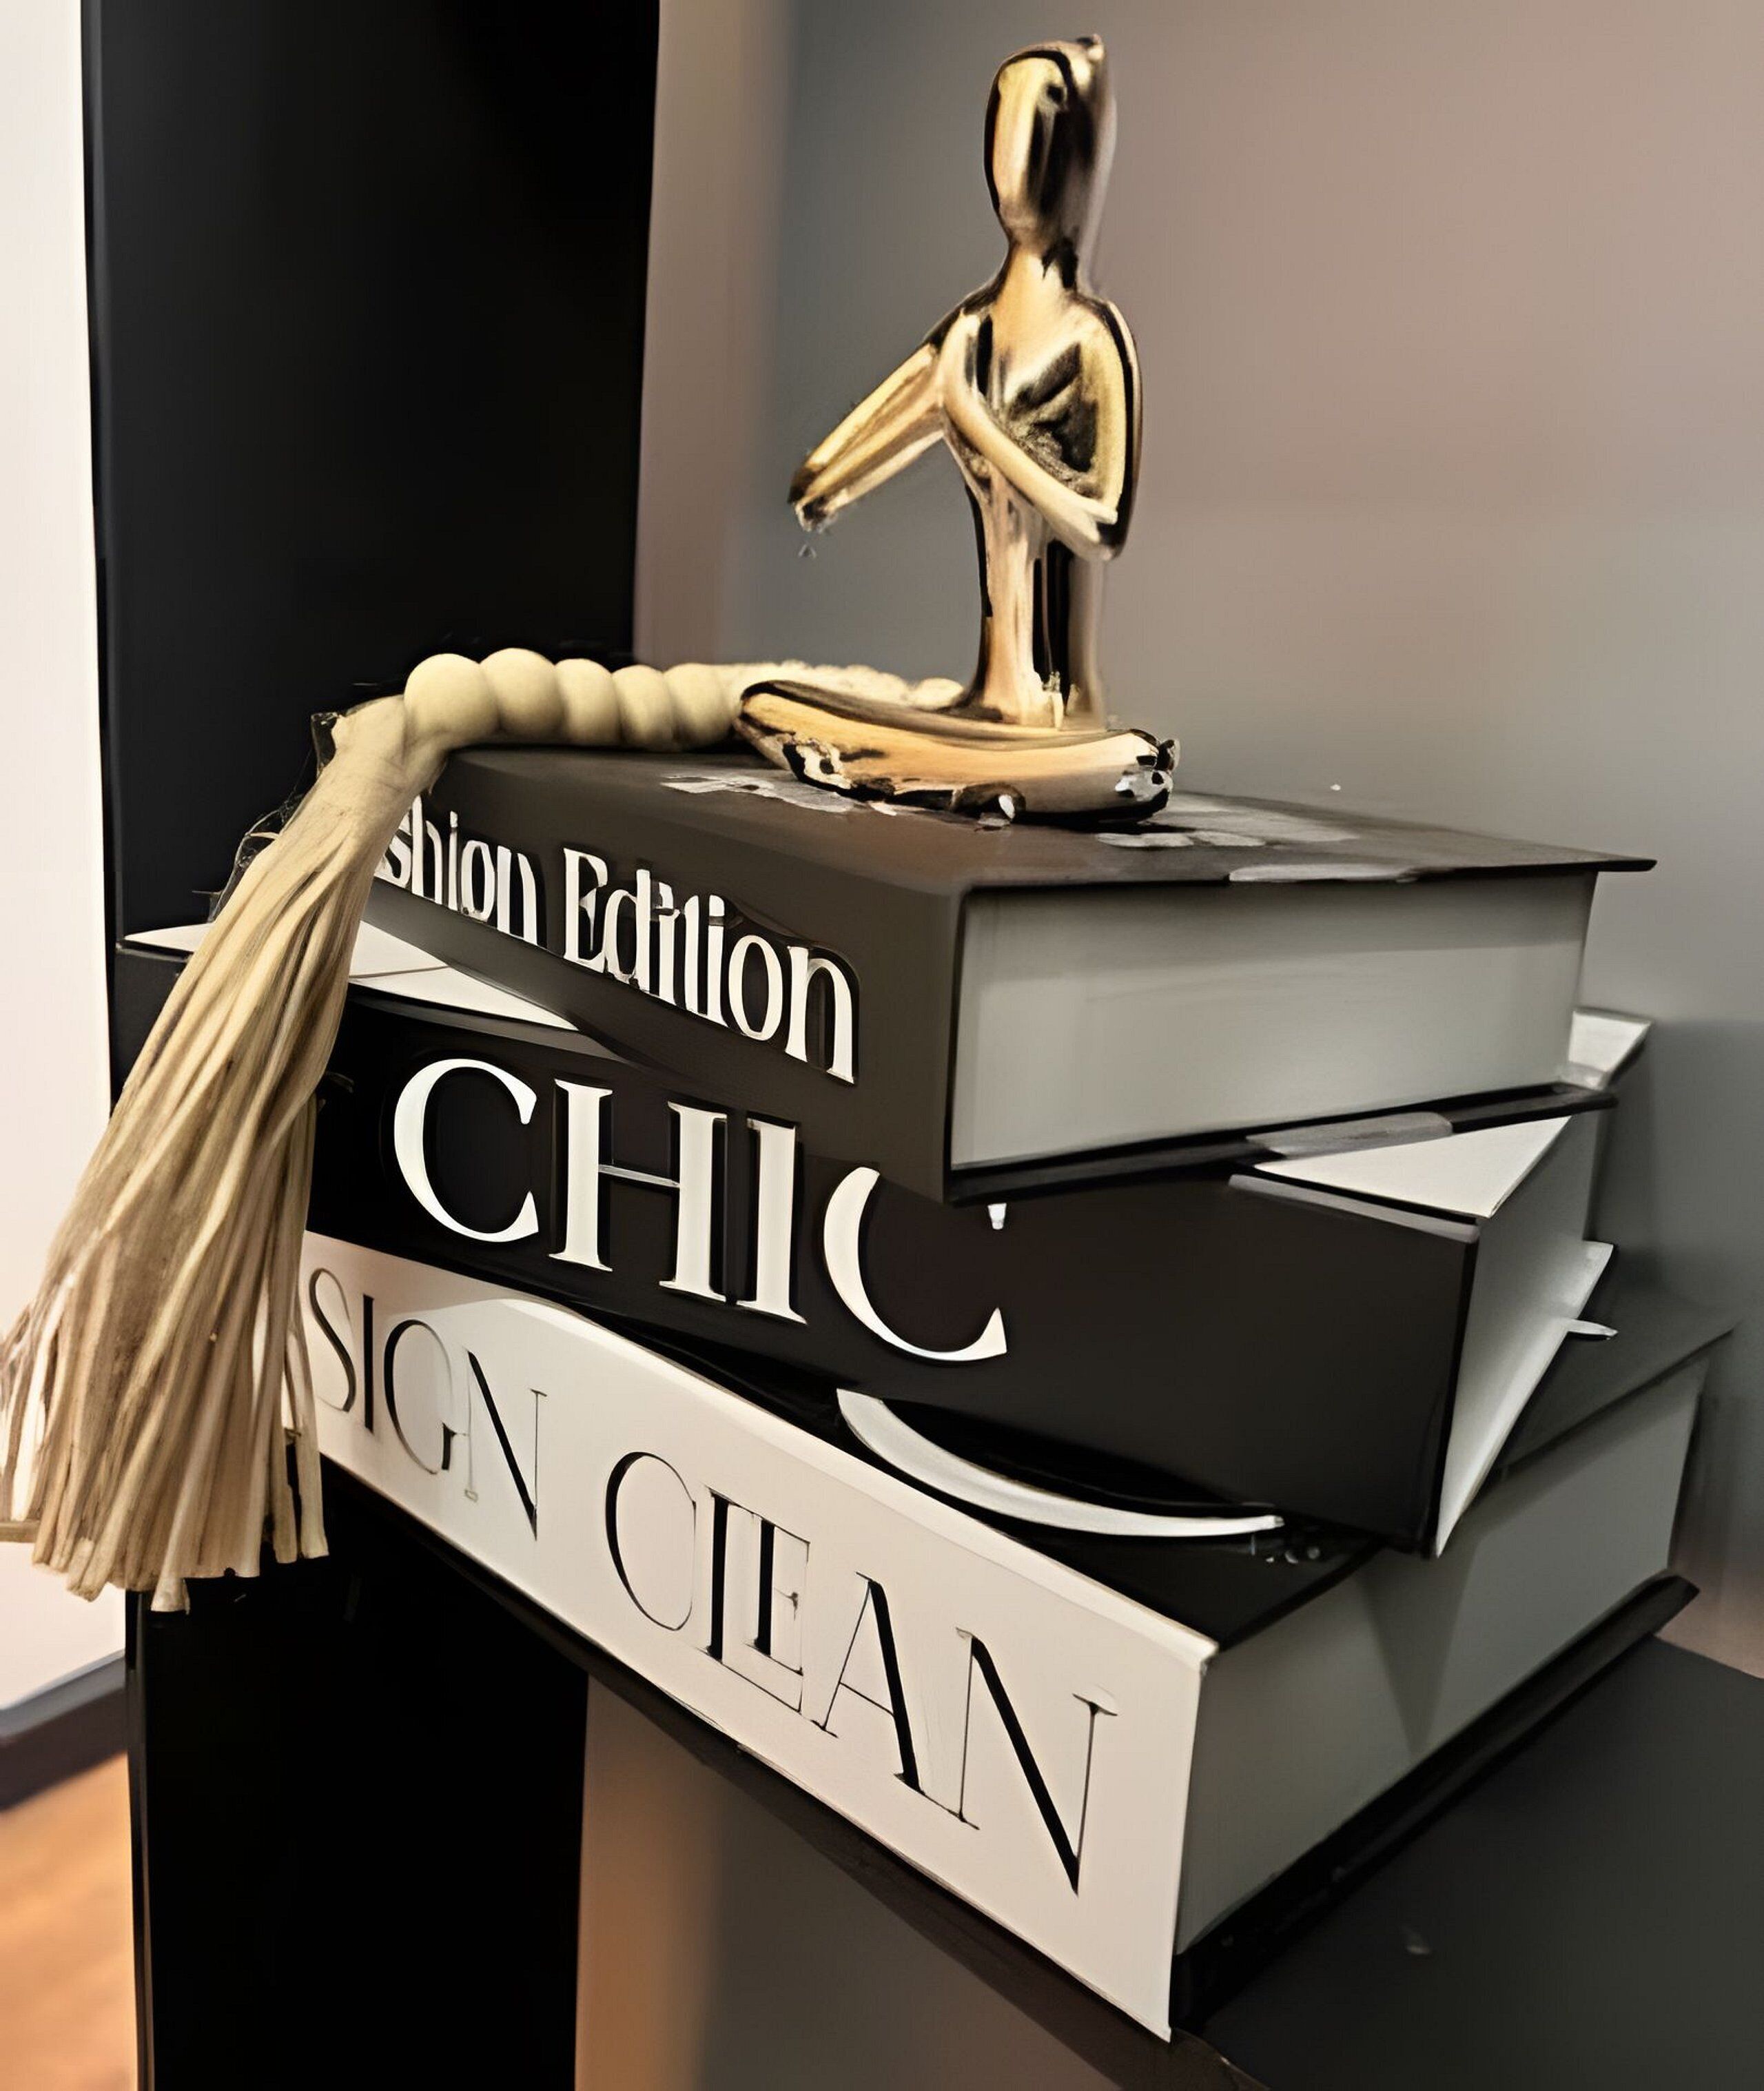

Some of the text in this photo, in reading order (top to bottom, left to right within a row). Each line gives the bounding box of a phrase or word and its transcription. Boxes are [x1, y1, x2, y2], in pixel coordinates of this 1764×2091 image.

[563, 848, 855, 1085] Edition
[393, 1058, 1007, 1361] CHIC
[606, 1451, 1118, 1896] CLEAN
